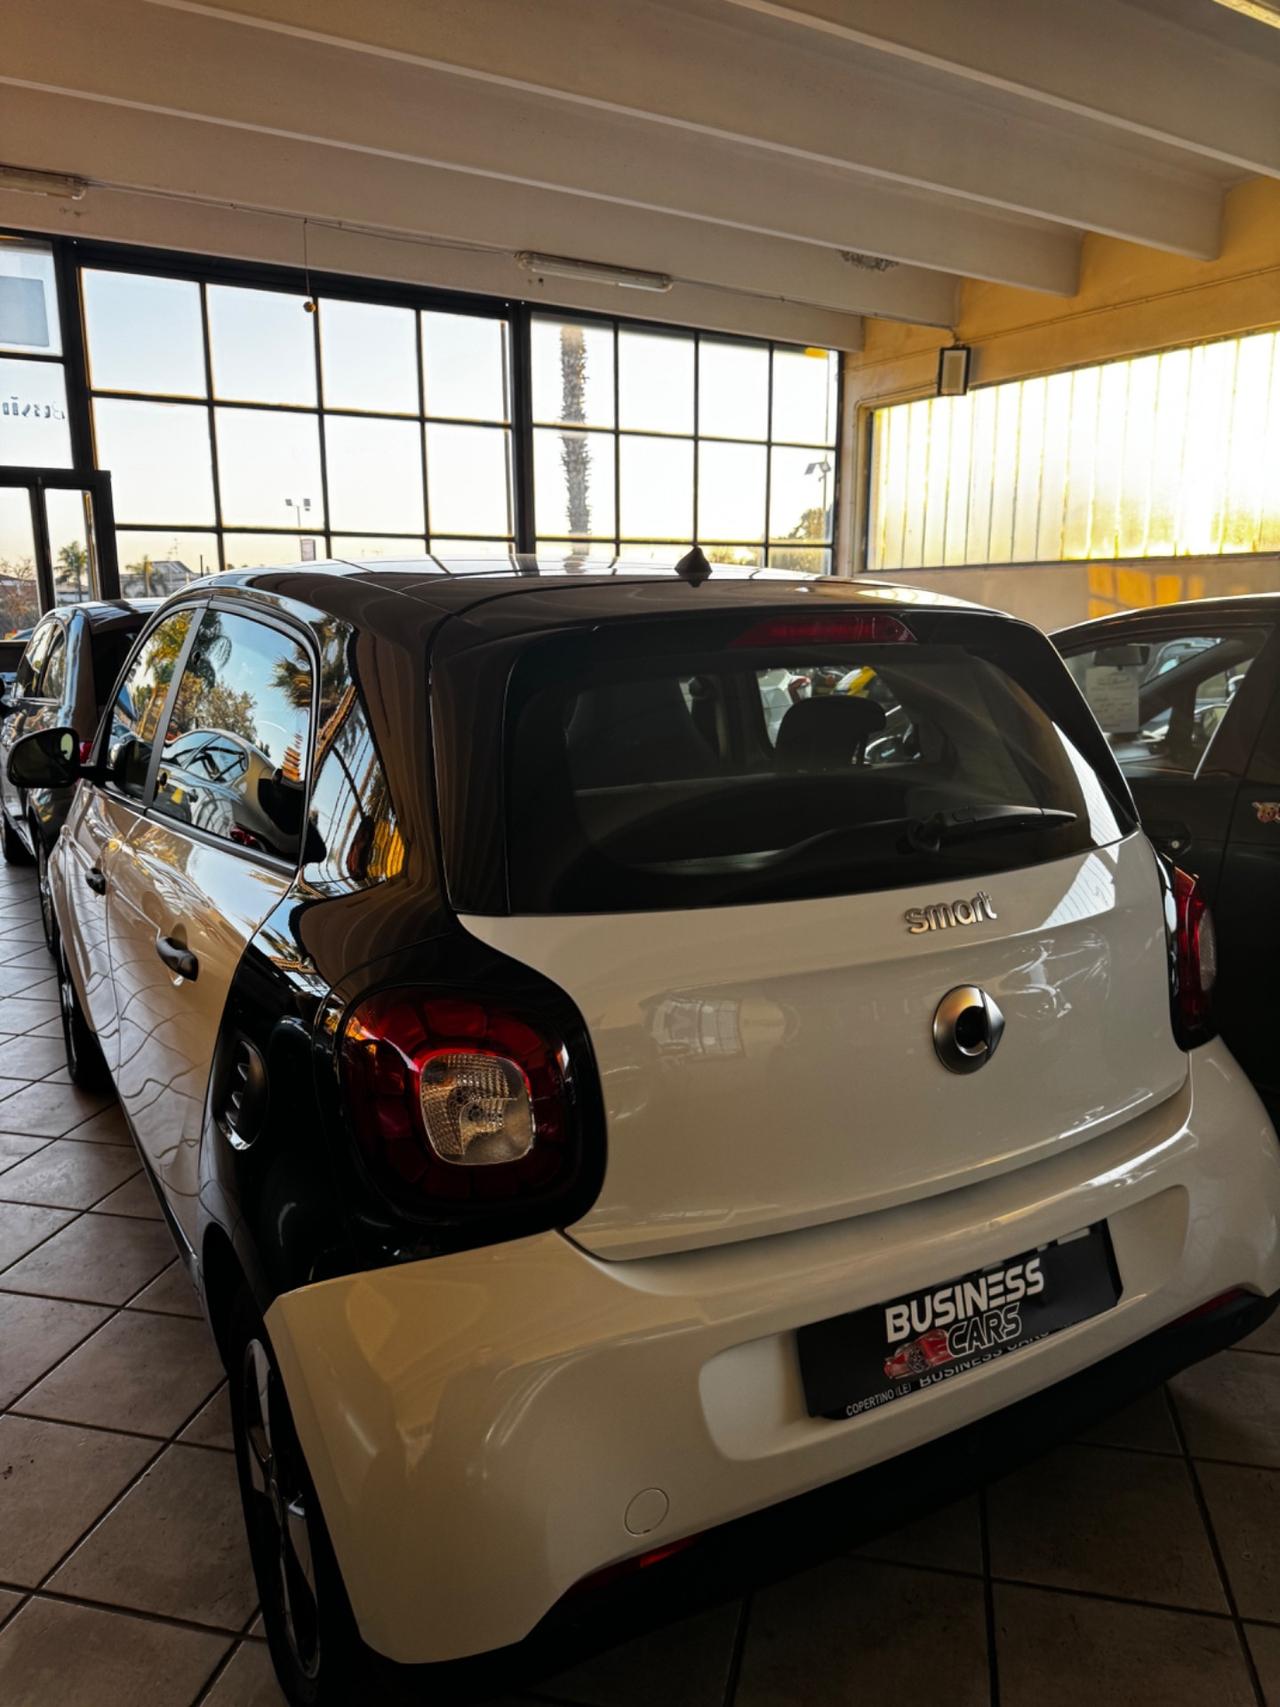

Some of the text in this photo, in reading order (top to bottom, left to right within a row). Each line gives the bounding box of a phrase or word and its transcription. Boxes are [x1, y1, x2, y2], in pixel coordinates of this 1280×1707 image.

[905, 891, 998, 934] smart
[885, 1258, 1044, 1343] BUSINESS
[946, 1302, 1022, 1358] CARS
[846, 1388, 895, 1416] COPERTINO
